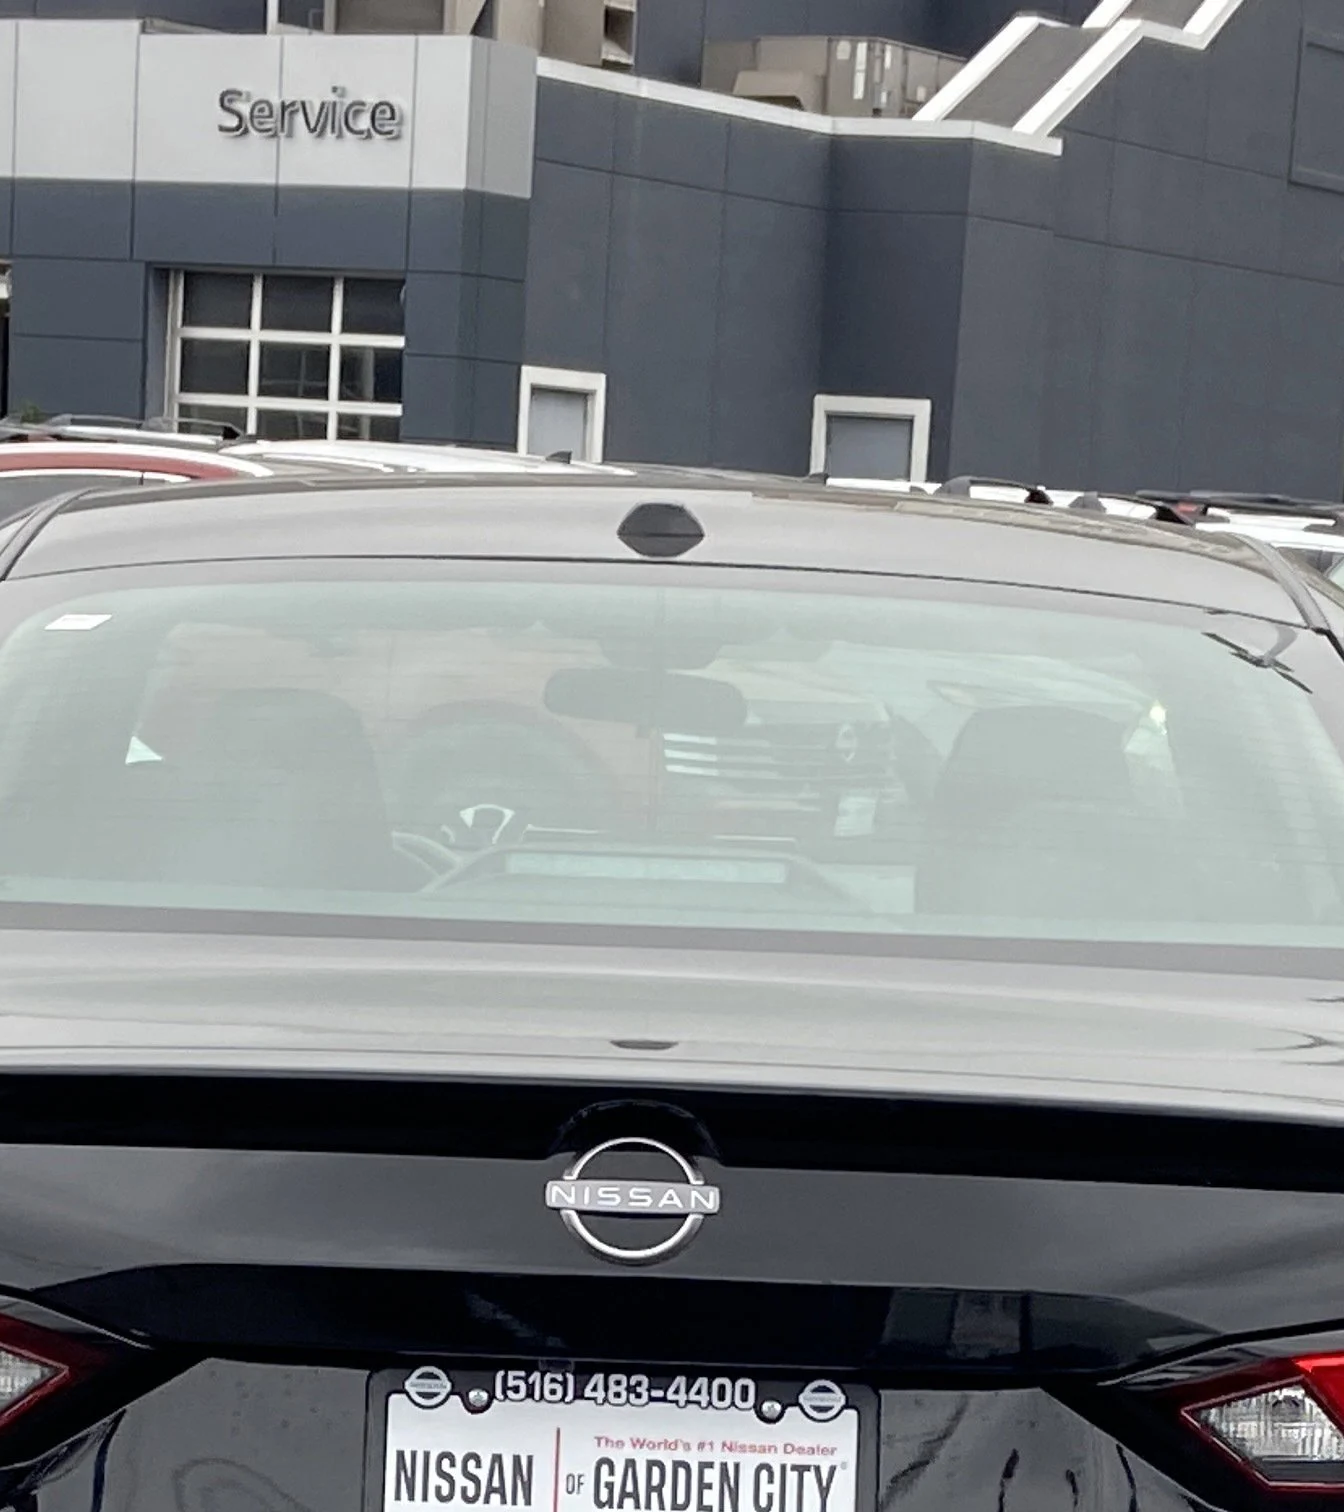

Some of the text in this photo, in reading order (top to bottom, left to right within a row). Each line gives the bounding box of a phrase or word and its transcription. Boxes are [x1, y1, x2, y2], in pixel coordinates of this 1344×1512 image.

[218, 86, 398, 137] Service
[551, 1184, 715, 1209] NISSAN
[495, 1370, 756, 1410] (516) 483-4400
[594, 1435, 837, 1456] The World's #1 Nissan Dealer
[394, 1449, 534, 1506] NISSAN
[566, 1472, 585, 1495] OF
